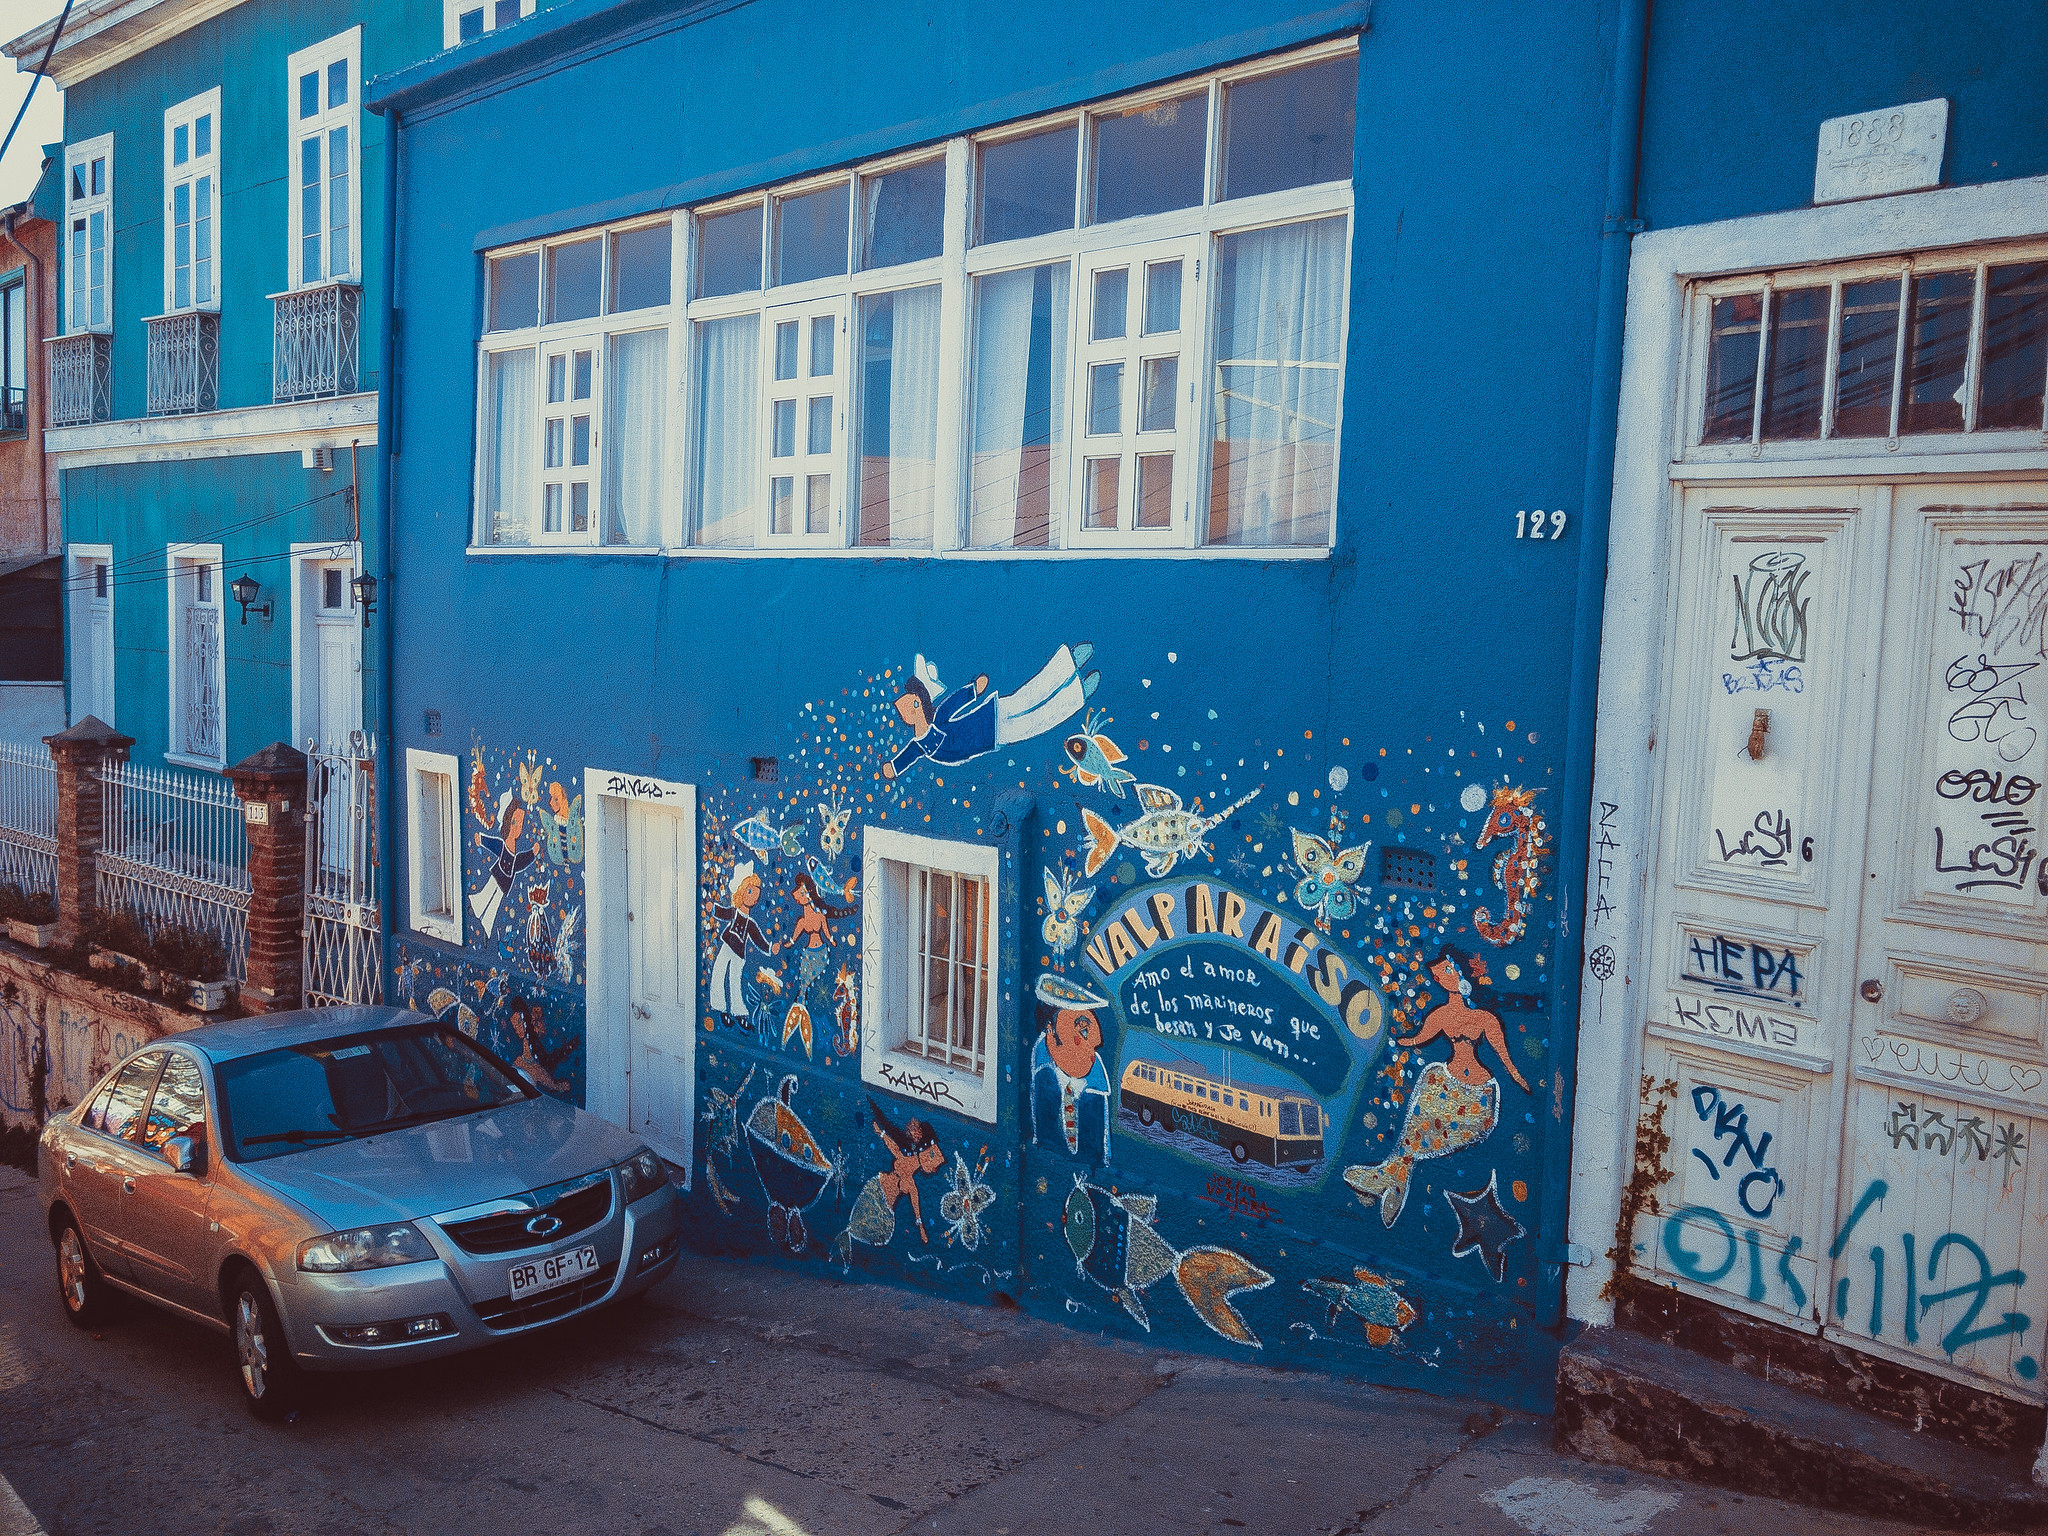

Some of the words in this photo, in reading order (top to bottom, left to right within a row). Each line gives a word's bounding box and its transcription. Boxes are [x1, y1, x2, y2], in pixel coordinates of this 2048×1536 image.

[1837, 113, 1905, 149] 1888
[1515, 509, 1567, 540] 129
[1132, 966, 1170, 989] Amo
[1690, 935, 1805, 997] HEPA
[1130, 993, 1150, 1015] de
[1157, 989, 1178, 1013] los
[1290, 1017, 1320, 1041] que
[1154, 1013, 1197, 1038] besan
[1204, 1021, 1214, 1039] y
